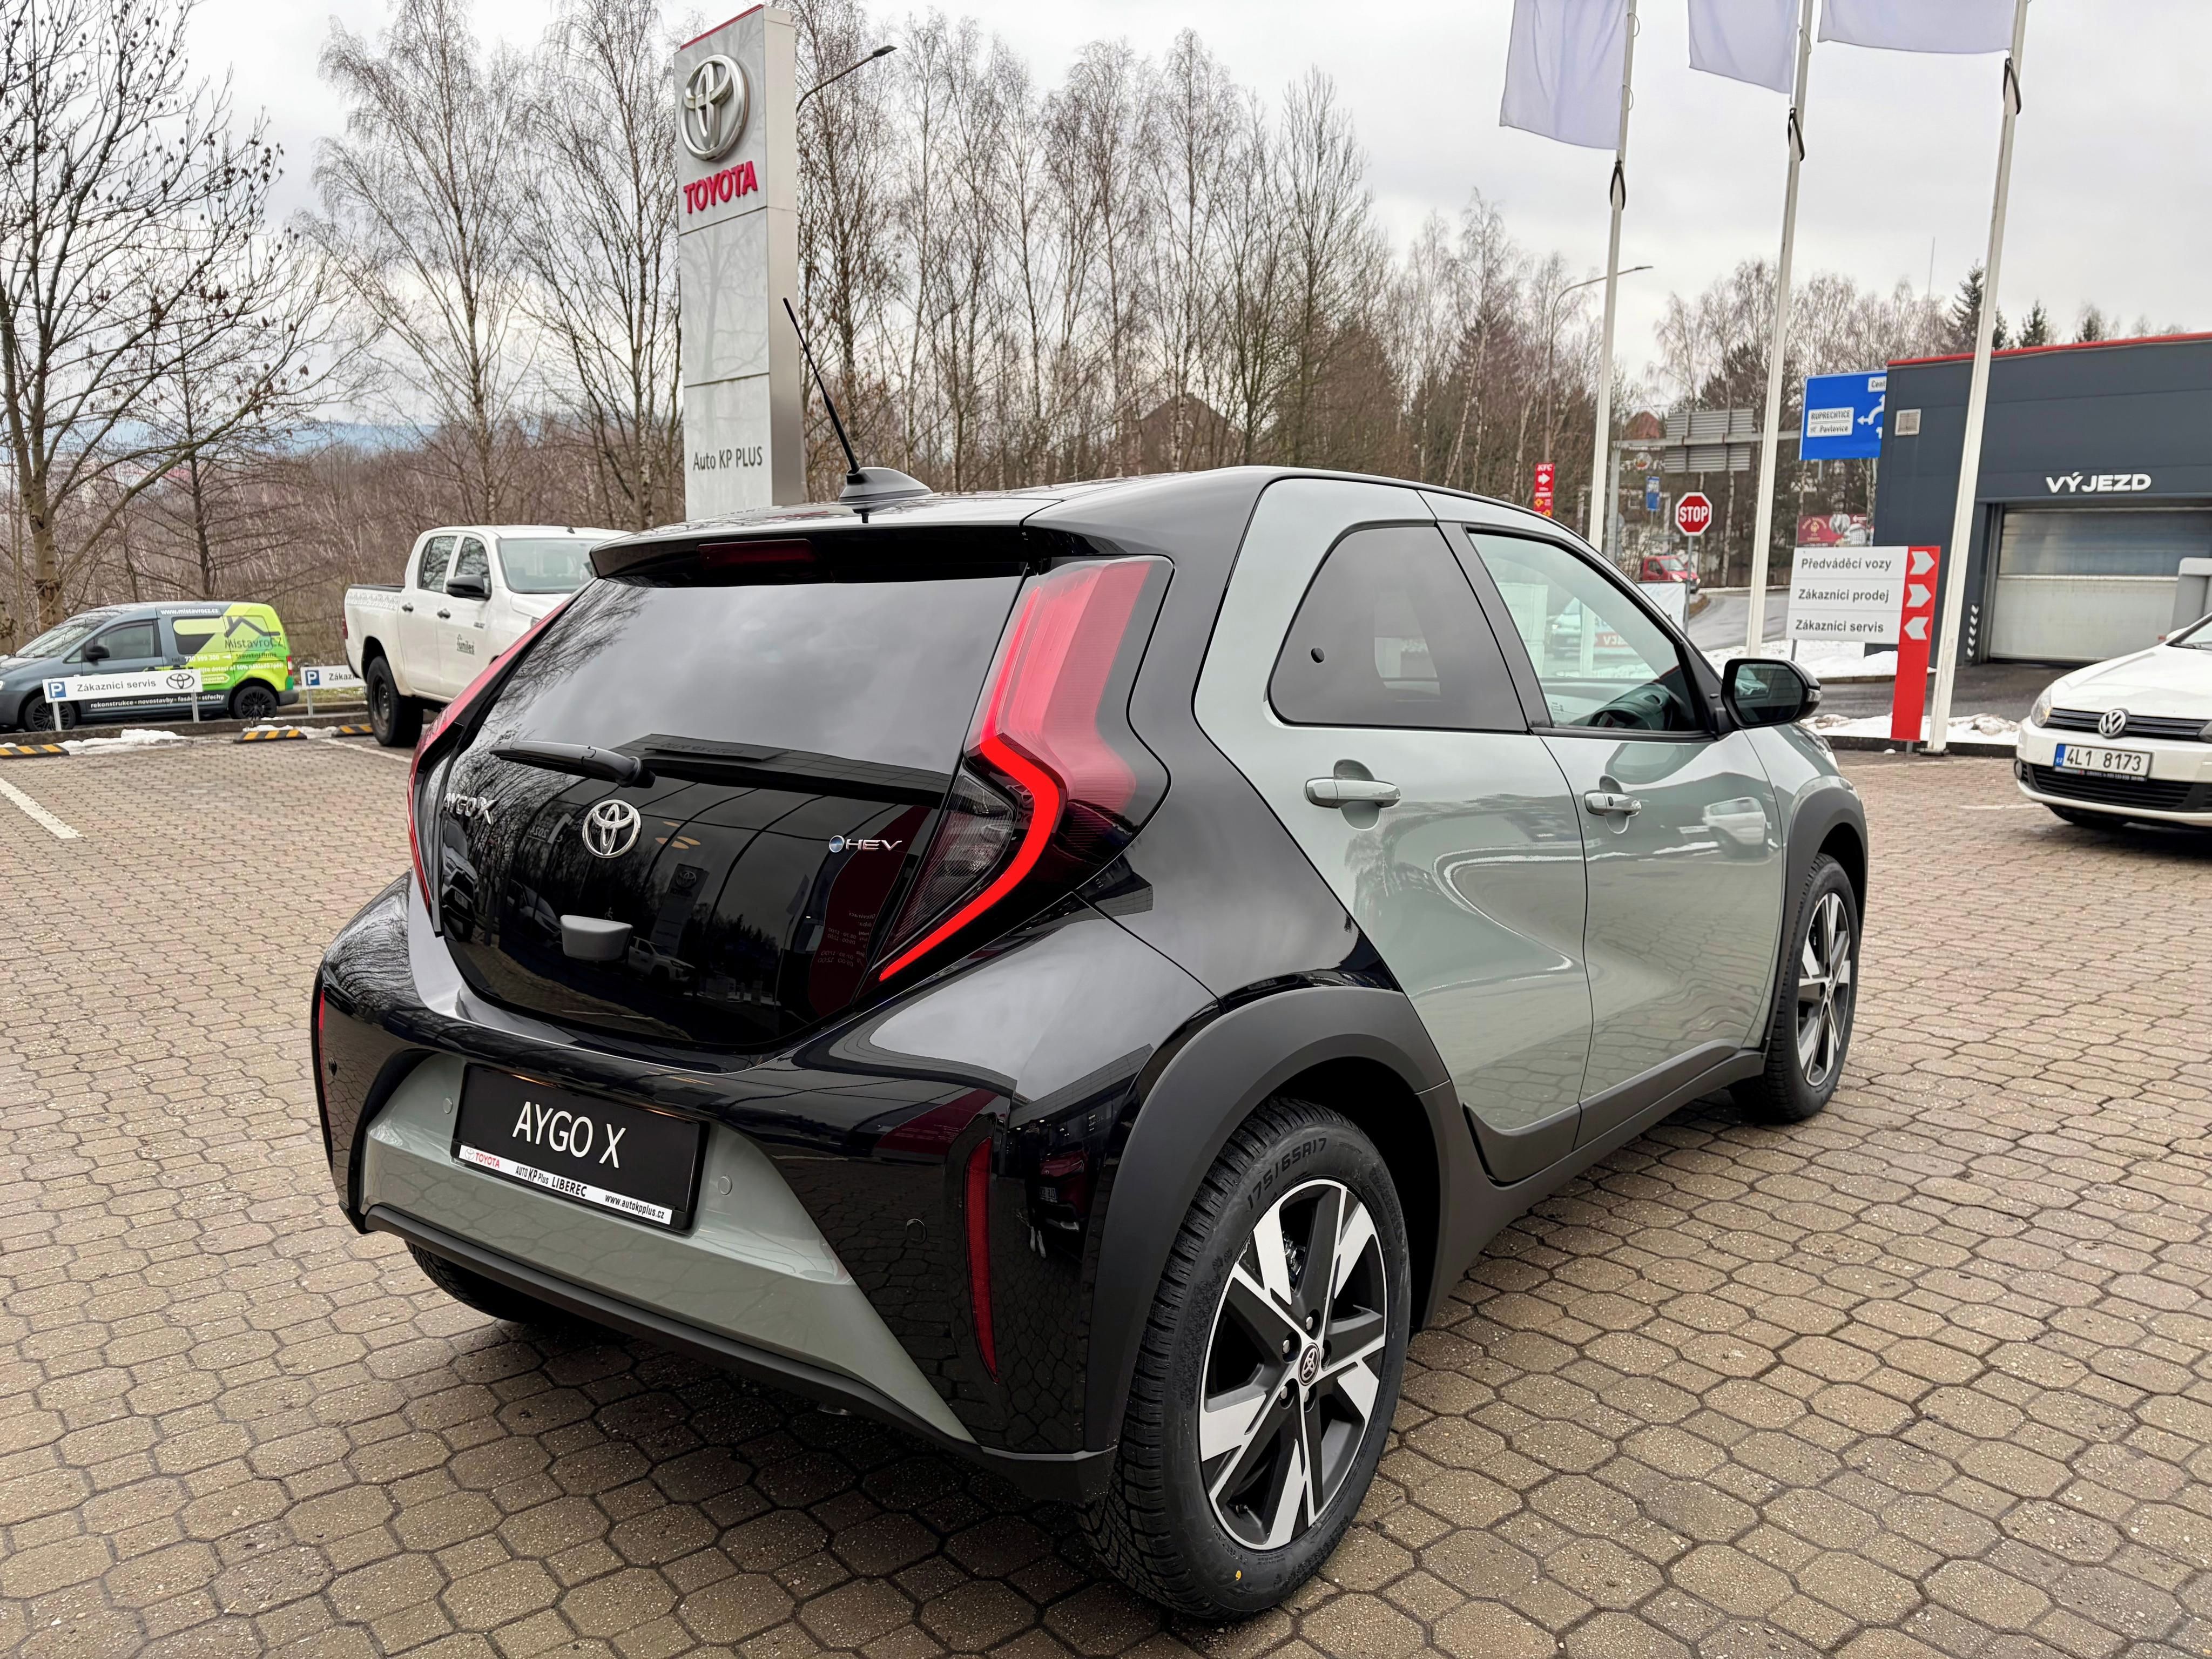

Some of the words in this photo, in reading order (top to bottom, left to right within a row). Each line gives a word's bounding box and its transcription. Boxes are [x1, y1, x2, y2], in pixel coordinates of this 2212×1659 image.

[683, 160, 758, 214] TOYOTA
[1871, 380, 1885, 388] Cent
[1819, 424, 1849, 433] Pavlovice
[693, 451, 716, 471] Auto
[719, 449, 732, 469] KP
[736, 446, 763, 468] PLUS
[2046, 471, 2152, 494] VÝJEZD
[1678, 507, 1709, 523] STOP
[1802, 557, 1862, 570] Předváděcí
[1865, 559, 1892, 572] vozy
[1798, 588, 1850, 601] Zákazníci
[1853, 589, 1890, 604] prodej
[1795, 619, 1847, 632] Zákazníci
[1850, 621, 1884, 633] servis
[307, 671, 317, 685] P
[51, 683, 63, 696] P
[77, 680, 124, 692] Zákazníci
[127, 679, 156, 689] servis
[91, 699, 133, 709] rekonstrukce
[138, 696, 174, 706] novostavby
[201, 693, 224, 702] střechy
[2067, 748, 2093, 767] 4L1
[2103, 752, 2142, 772] 8173
[845, 839, 902, 851] HEV
[512, 1101, 594, 1158] AYGO
[599, 1123, 626, 1169] X
[1246, 1137, 1327, 1210] 175/65R17
[475, 1152, 500, 1168] TOYOTA
[515, 1165, 528, 1177] AUTO
[528, 1167, 538, 1182] KP
[537, 1172, 549, 1185] Plus
[551, 1176, 587, 1197] LIBEREC
[605, 1194, 665, 1219] www.autokpplus.cz
